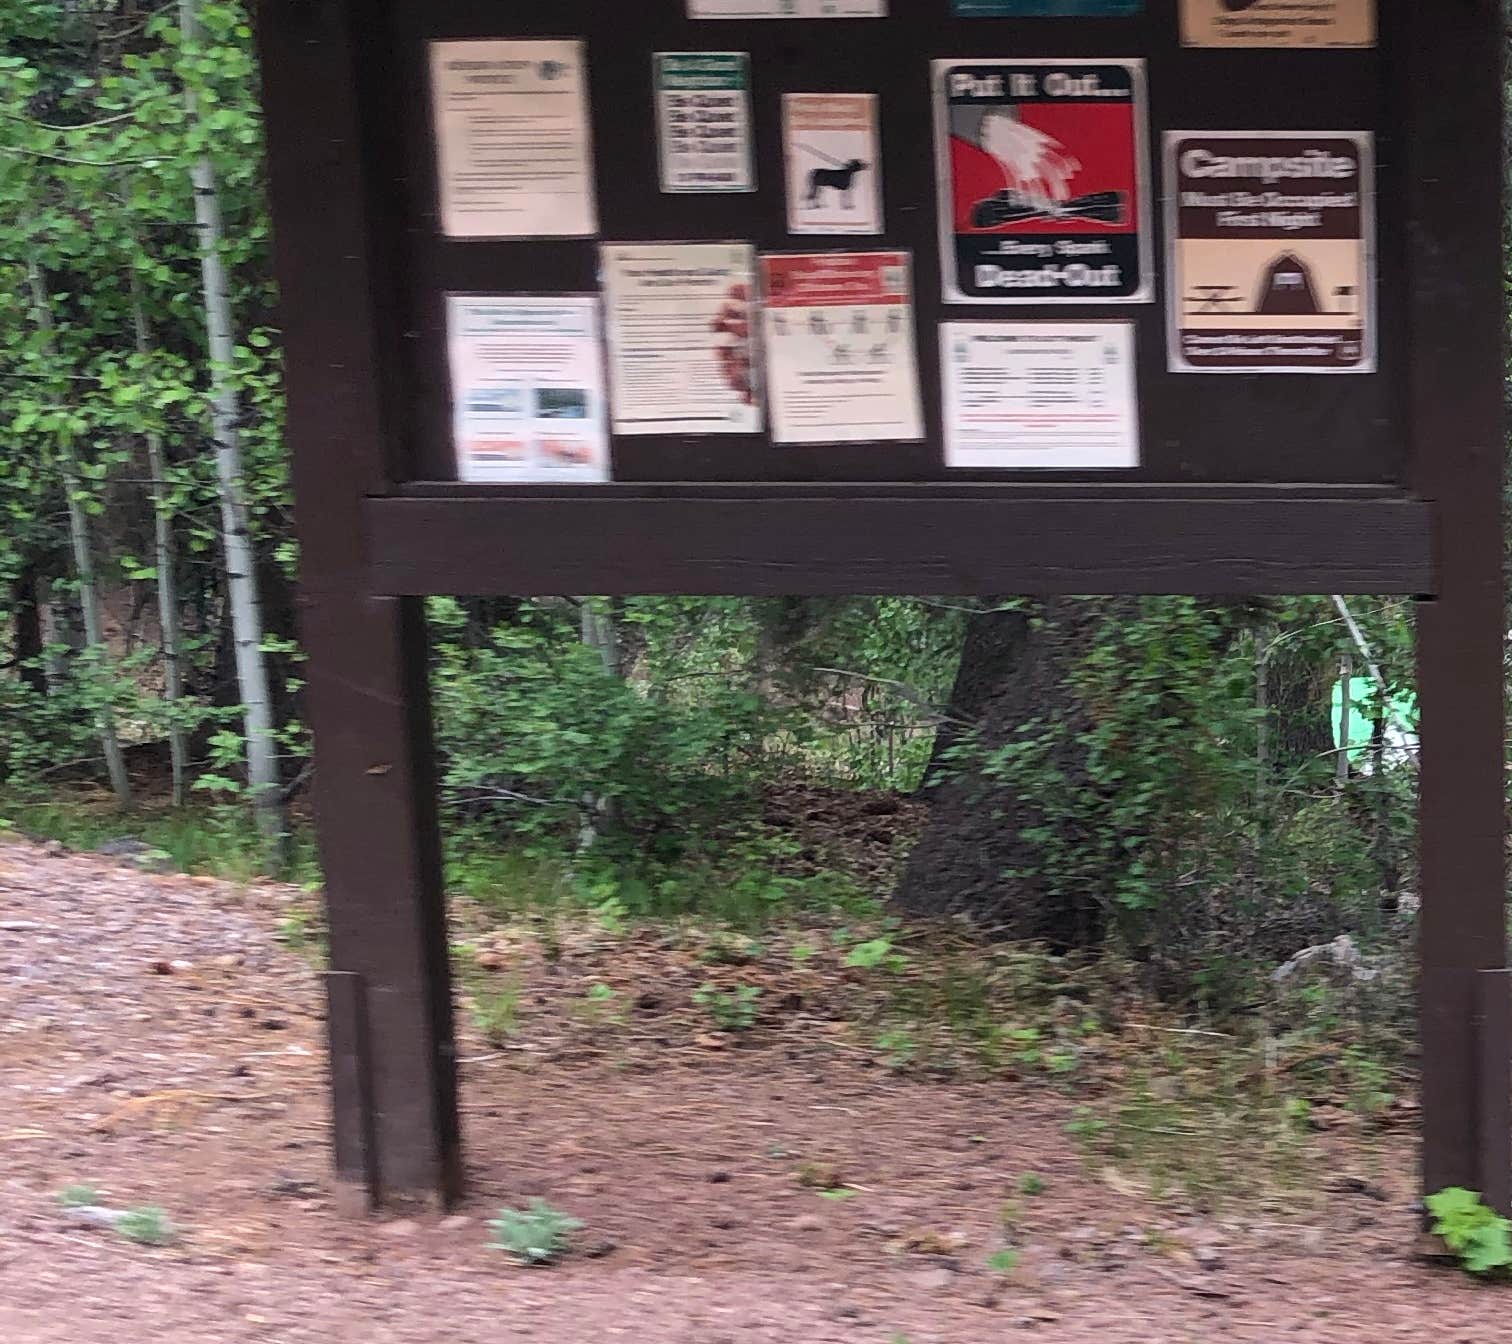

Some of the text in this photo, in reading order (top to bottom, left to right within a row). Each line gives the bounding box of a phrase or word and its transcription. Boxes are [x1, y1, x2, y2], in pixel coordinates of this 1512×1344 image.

[950, 73, 1005, 97] Put
[1008, 73, 1039, 97] It
[1180, 149, 1357, 184] Campsite
